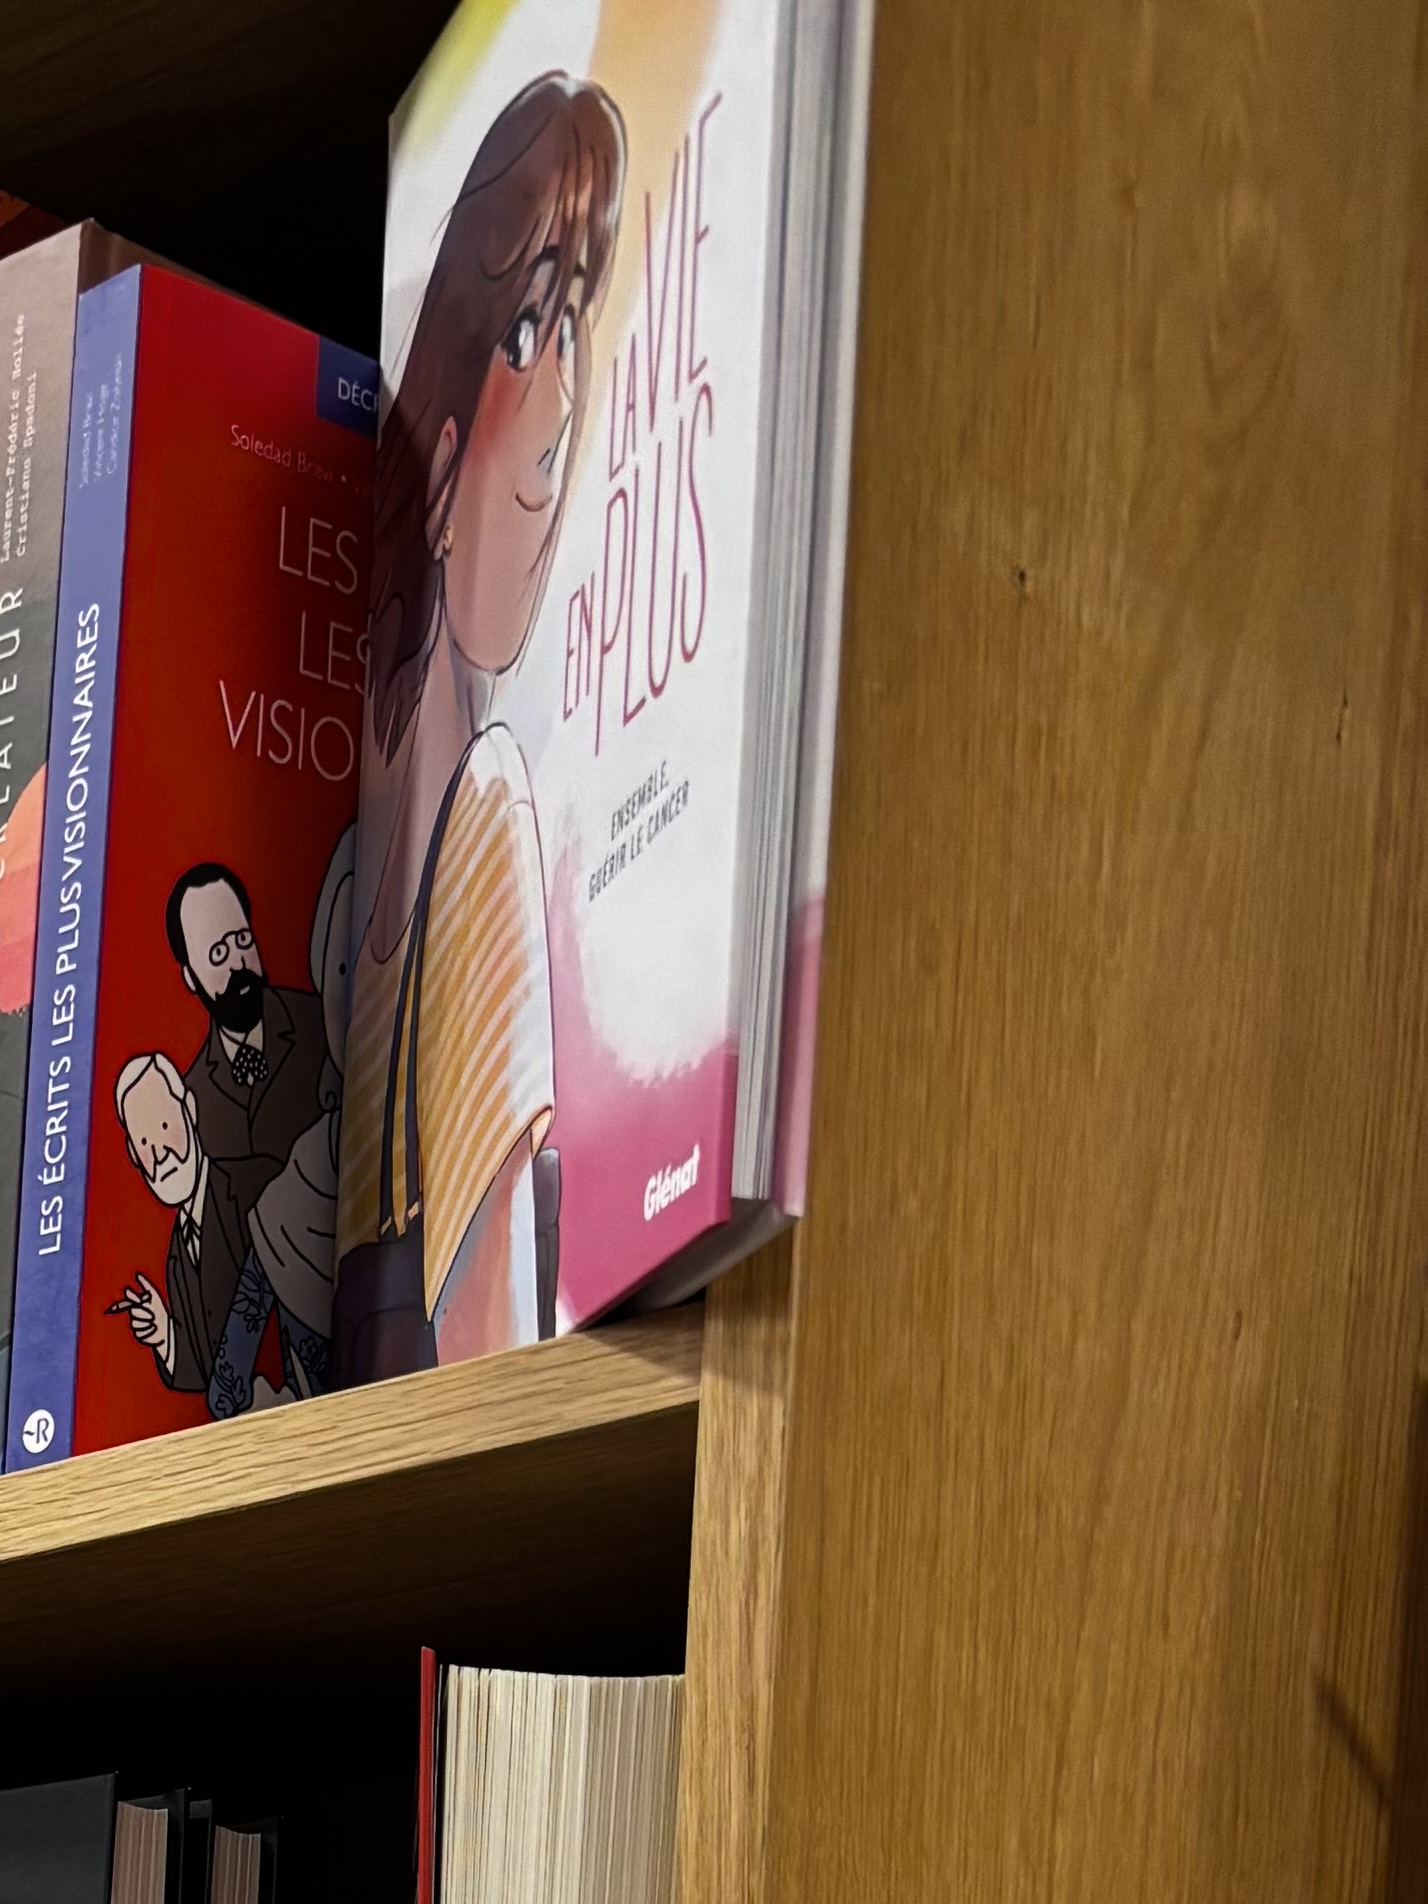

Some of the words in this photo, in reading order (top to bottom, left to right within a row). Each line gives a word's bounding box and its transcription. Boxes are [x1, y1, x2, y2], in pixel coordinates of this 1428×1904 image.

[609, 333, 640, 480] LA
[644, 93, 723, 416] VIE
[562, 573, 597, 724] EN
[590, 383, 713, 759] PLUS
[63, 602, 102, 879] VISIONNAIRES
[55, 882, 83, 976] PLUS
[50, 983, 77, 1047] LES
[41, 1056, 74, 1187] ÉCRITS
[38, 1195, 64, 1257] LES
